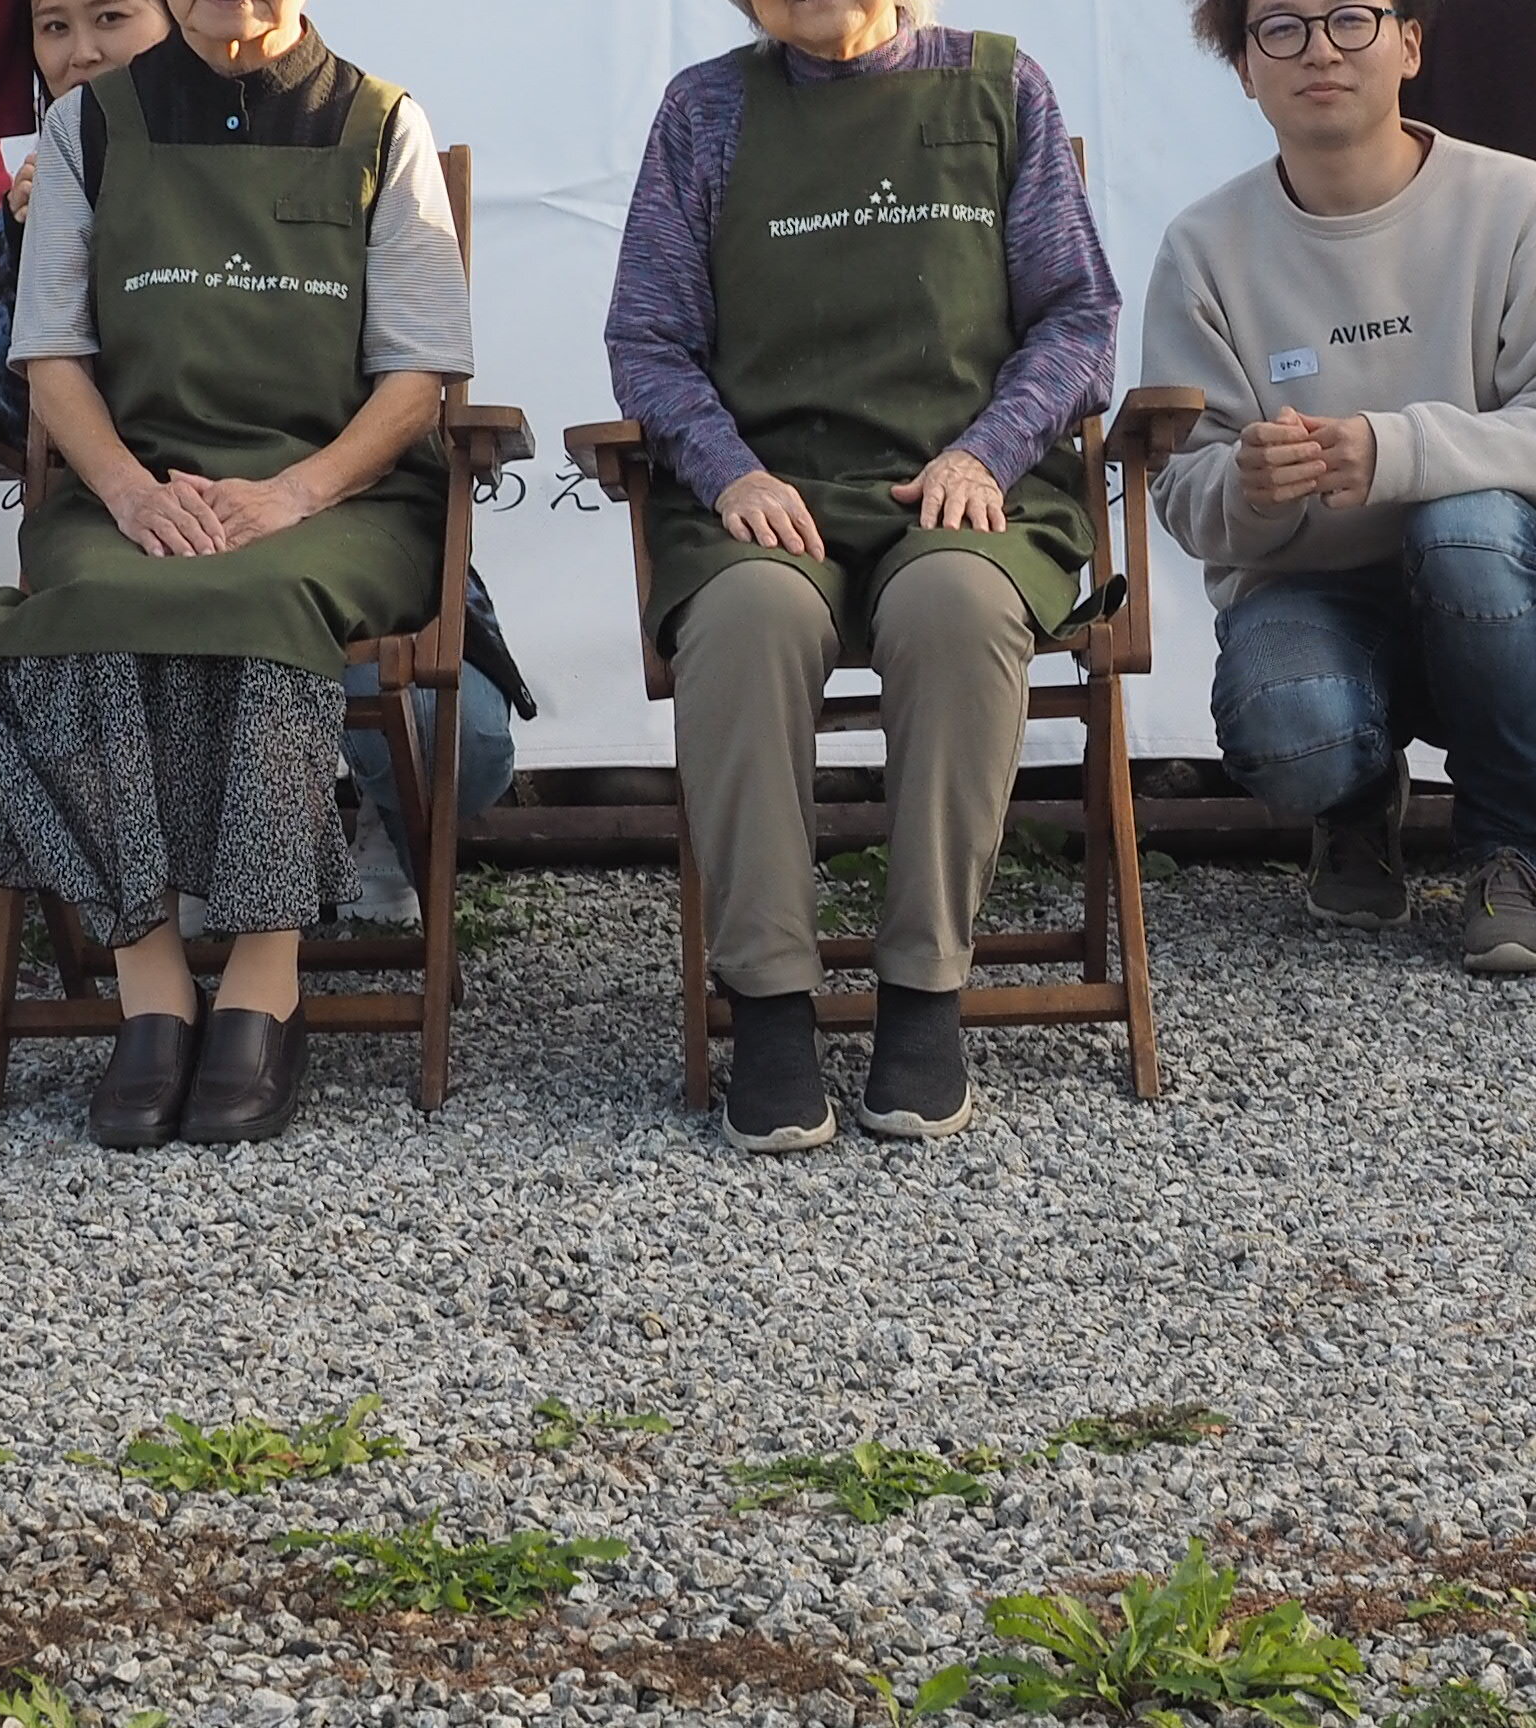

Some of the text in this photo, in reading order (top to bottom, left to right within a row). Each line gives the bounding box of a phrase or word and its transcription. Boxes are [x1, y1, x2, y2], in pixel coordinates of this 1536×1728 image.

[768, 208, 850, 238] RESTAURANT
[854, 207, 874, 226] OF
[952, 203, 995, 228] ORDERS
[124, 268, 199, 293] RESTAURANT
[204, 273, 223, 288] OF
[304, 278, 349, 300] ORDERS
[1329, 315, 1413, 345] AVIREX
